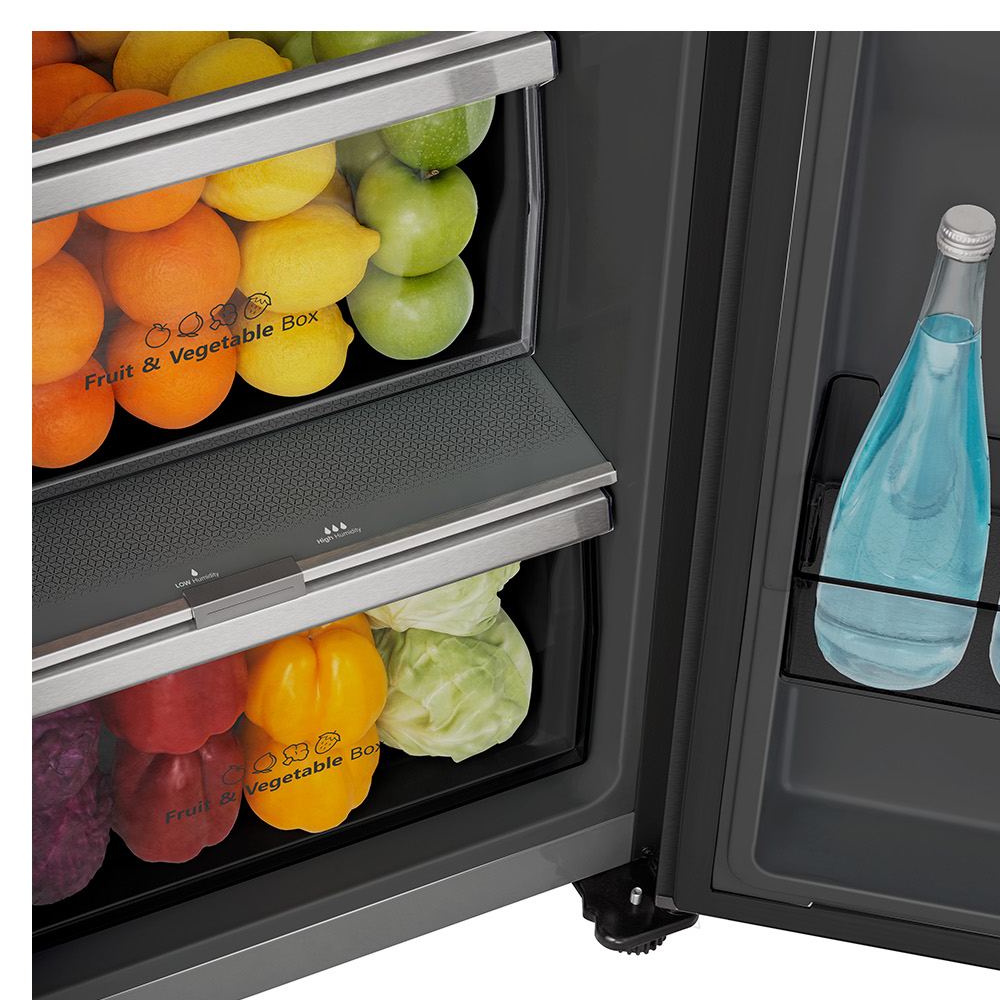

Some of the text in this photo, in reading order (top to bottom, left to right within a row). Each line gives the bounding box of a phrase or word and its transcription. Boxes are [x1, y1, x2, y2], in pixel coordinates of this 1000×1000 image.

[84, 310, 320, 391] Fruit & Vegetable Box
[316, 527, 362, 545] High Humidity
[191, 572, 219, 584] Humidity
[165, 799, 212, 825] Fruit
[219, 791, 237, 805] &
[245, 754, 344, 796] Vegetable
